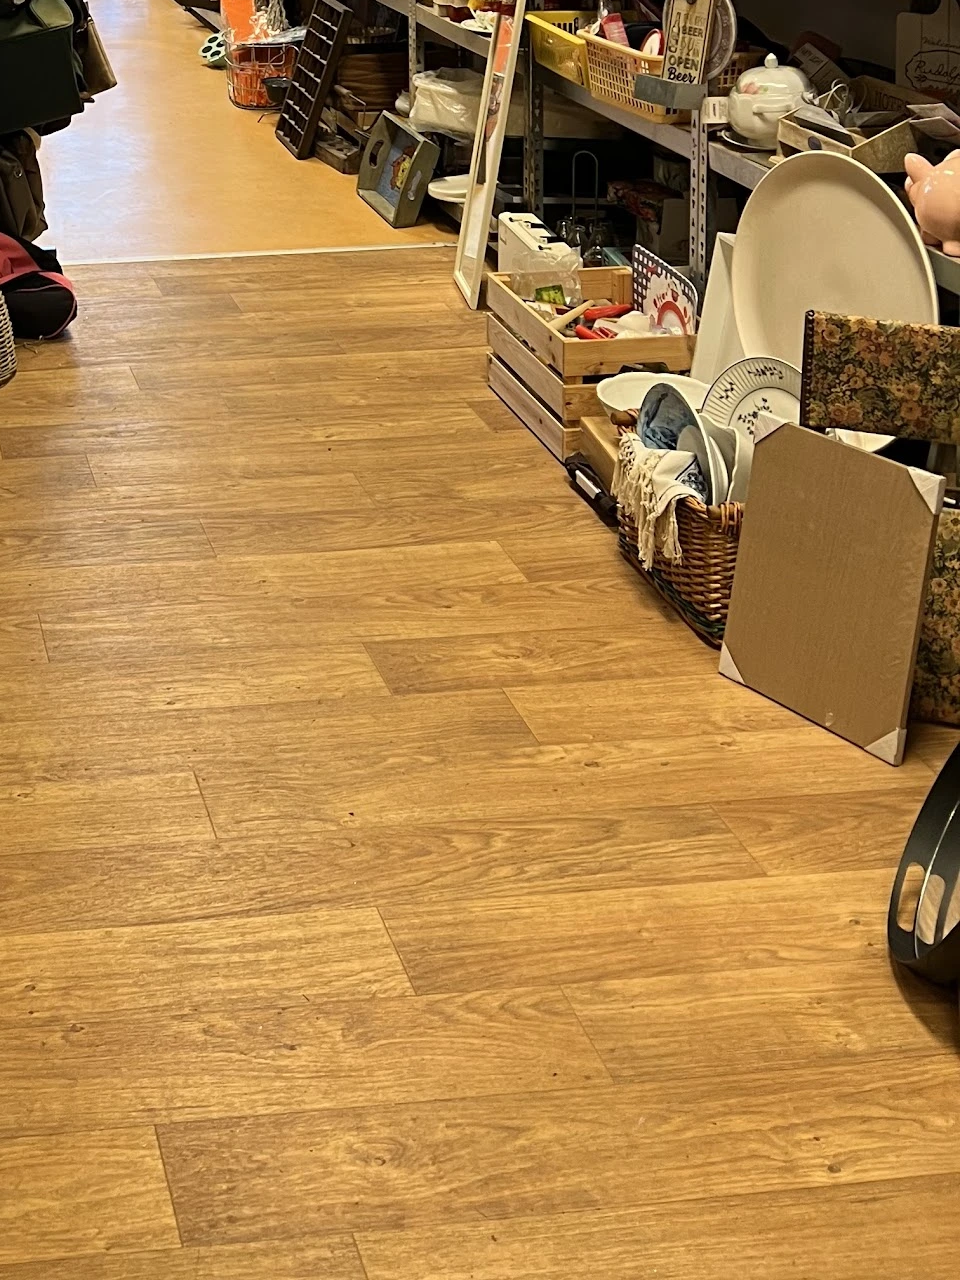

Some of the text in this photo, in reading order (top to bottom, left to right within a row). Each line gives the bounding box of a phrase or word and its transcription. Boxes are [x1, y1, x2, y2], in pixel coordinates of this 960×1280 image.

[682, 25, 703, 38] BEER
[668, 55, 699, 71] OPEN
[667, 67, 696, 85] Beer
